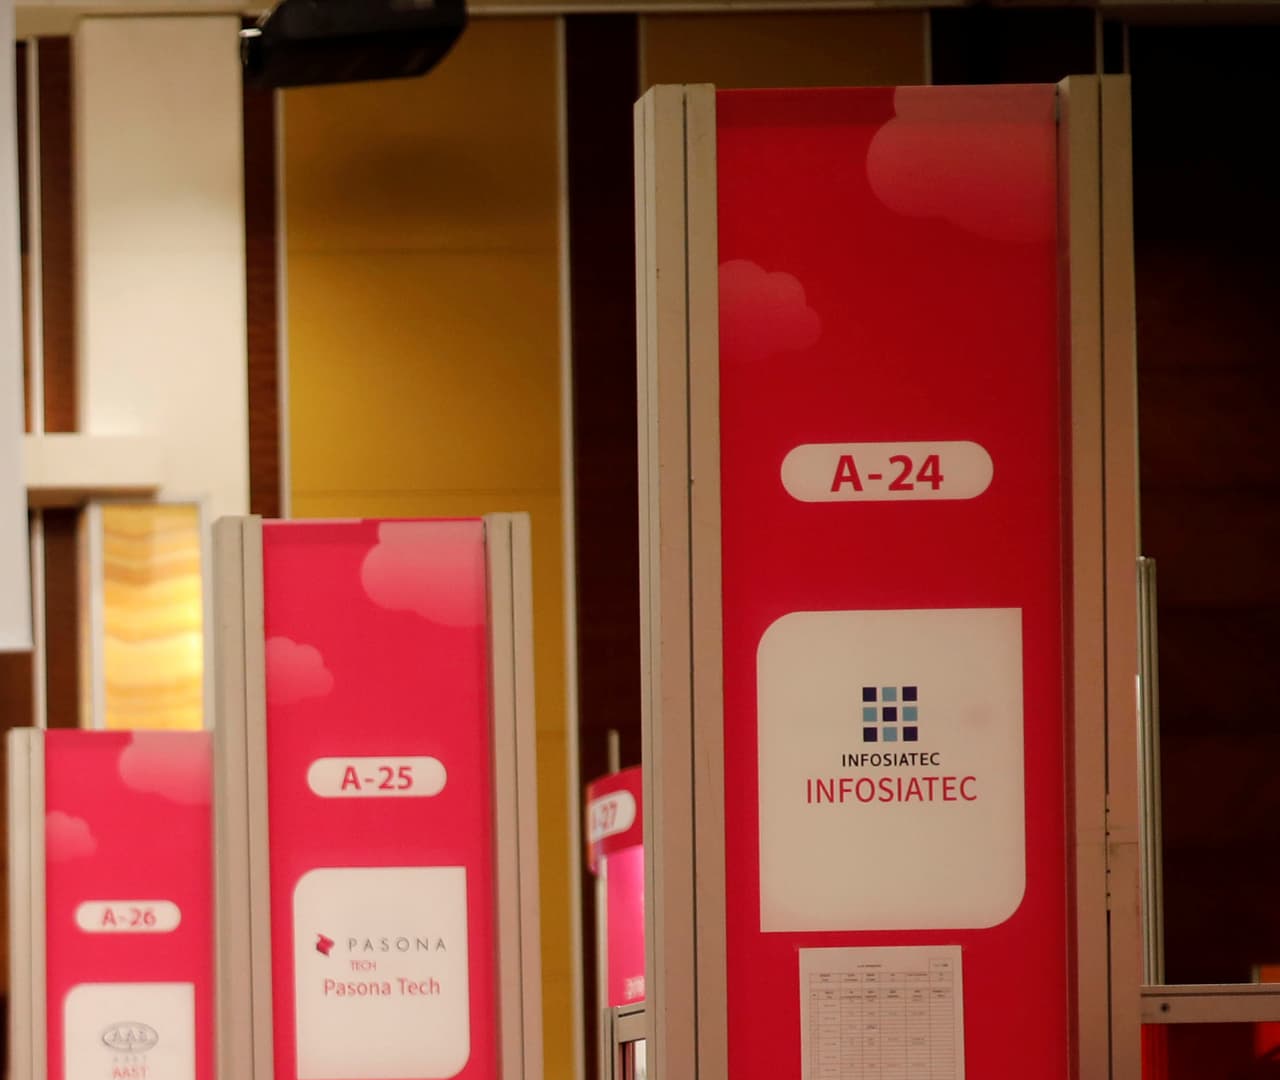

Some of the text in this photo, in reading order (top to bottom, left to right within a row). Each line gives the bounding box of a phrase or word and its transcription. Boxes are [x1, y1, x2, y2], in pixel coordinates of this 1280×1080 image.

[830, 454, 944, 492] A-24
[842, 753, 940, 767] INFOSIATEC
[341, 765, 414, 791] A-25
[807, 776, 977, 804] INFOSIATEC
[101, 907, 157, 928] A-26
[348, 937, 447, 952] PASONA
[324, 976, 441, 997] Pasona Tech
